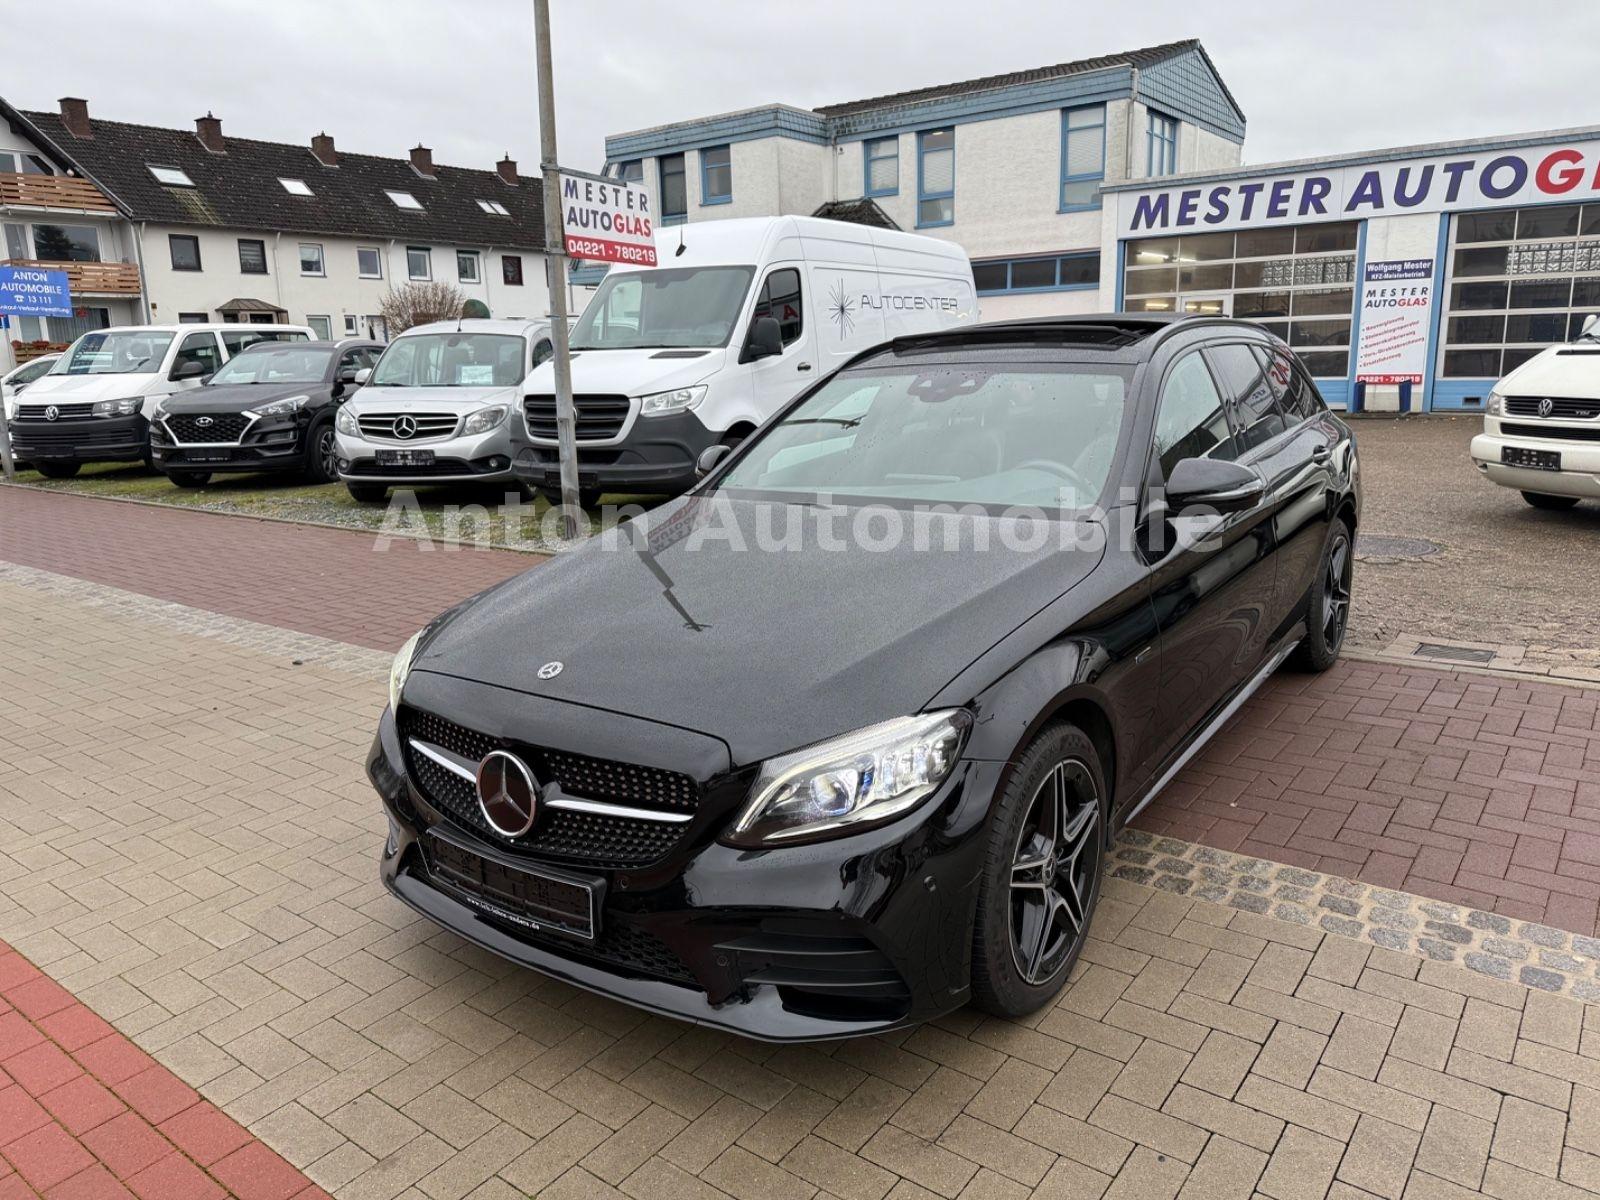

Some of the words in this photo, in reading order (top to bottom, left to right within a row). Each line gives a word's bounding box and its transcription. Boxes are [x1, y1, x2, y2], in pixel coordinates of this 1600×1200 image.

[564, 178, 648, 212] MESTER
[1129, 177, 1332, 231] MESTER
[1344, 149, 1600, 212] AUTOG
[566, 206, 652, 237] AUTOGLAS
[1367, 263, 1402, 272] Wolfgang
[1404, 261, 1431, 270] Mester
[13, 272, 47, 281] ANTON
[0, 283, 62, 294] AUTOMOBILE
[1366, 287, 1428, 297] MESTER
[860, 295, 958, 310] AUTOCENTER
[1365, 298, 1428, 308] AUTOGLAS
